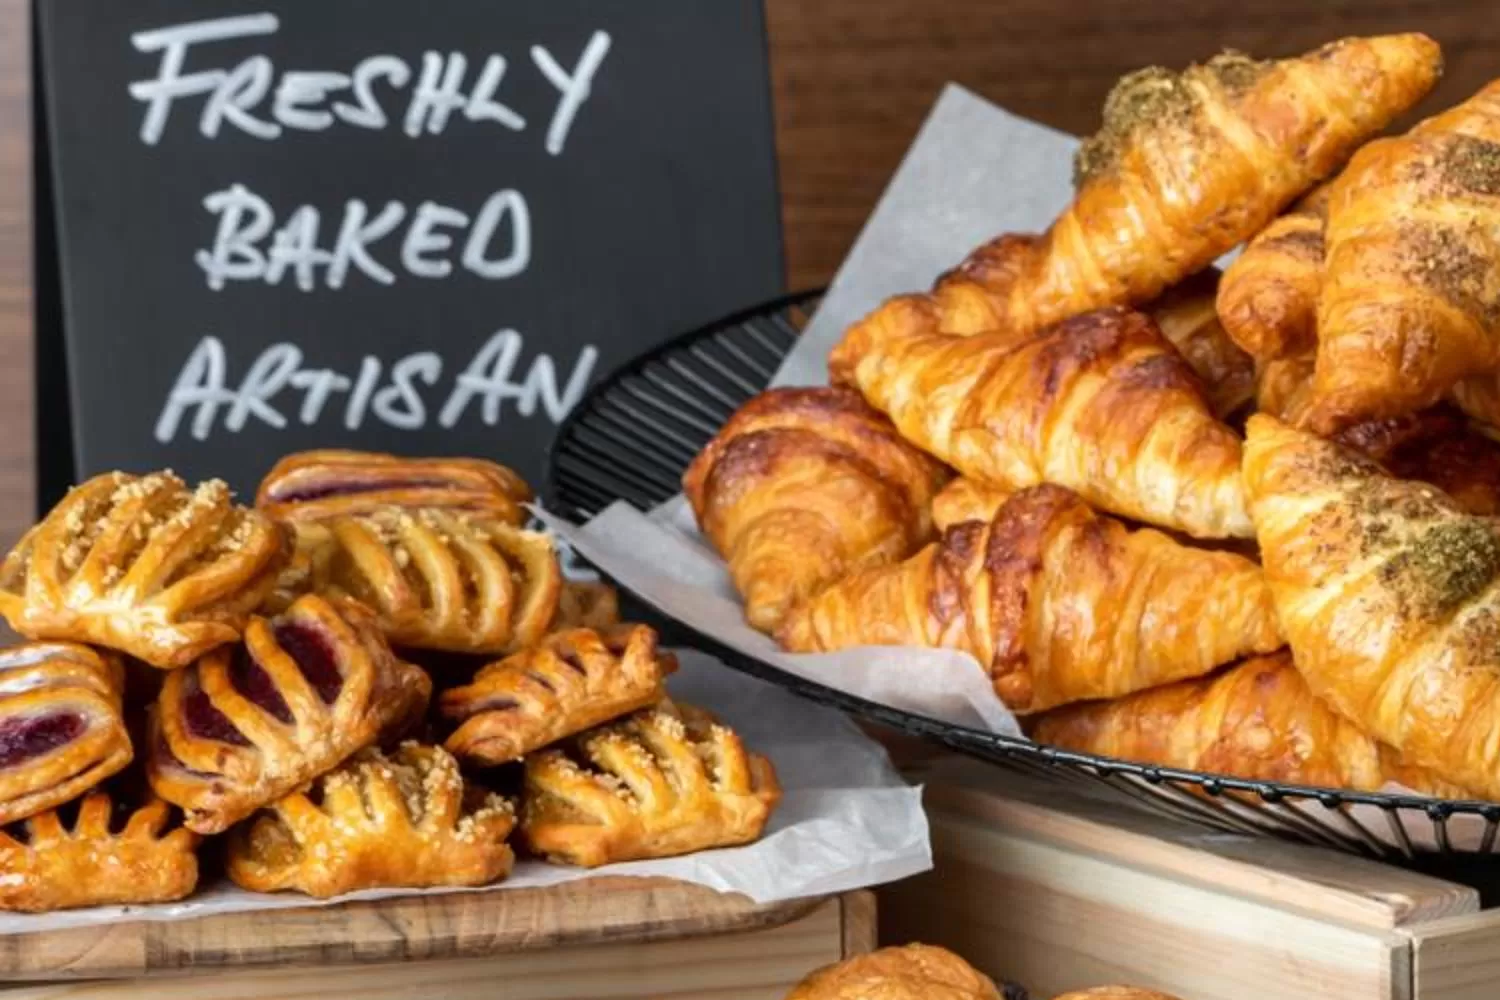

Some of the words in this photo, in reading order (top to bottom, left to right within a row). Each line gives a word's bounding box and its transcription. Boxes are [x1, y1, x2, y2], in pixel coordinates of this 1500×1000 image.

[127, 12, 612, 155] FRESHLY
[195, 183, 531, 292] BAKED
[154, 328, 598, 443] ARTISAN
